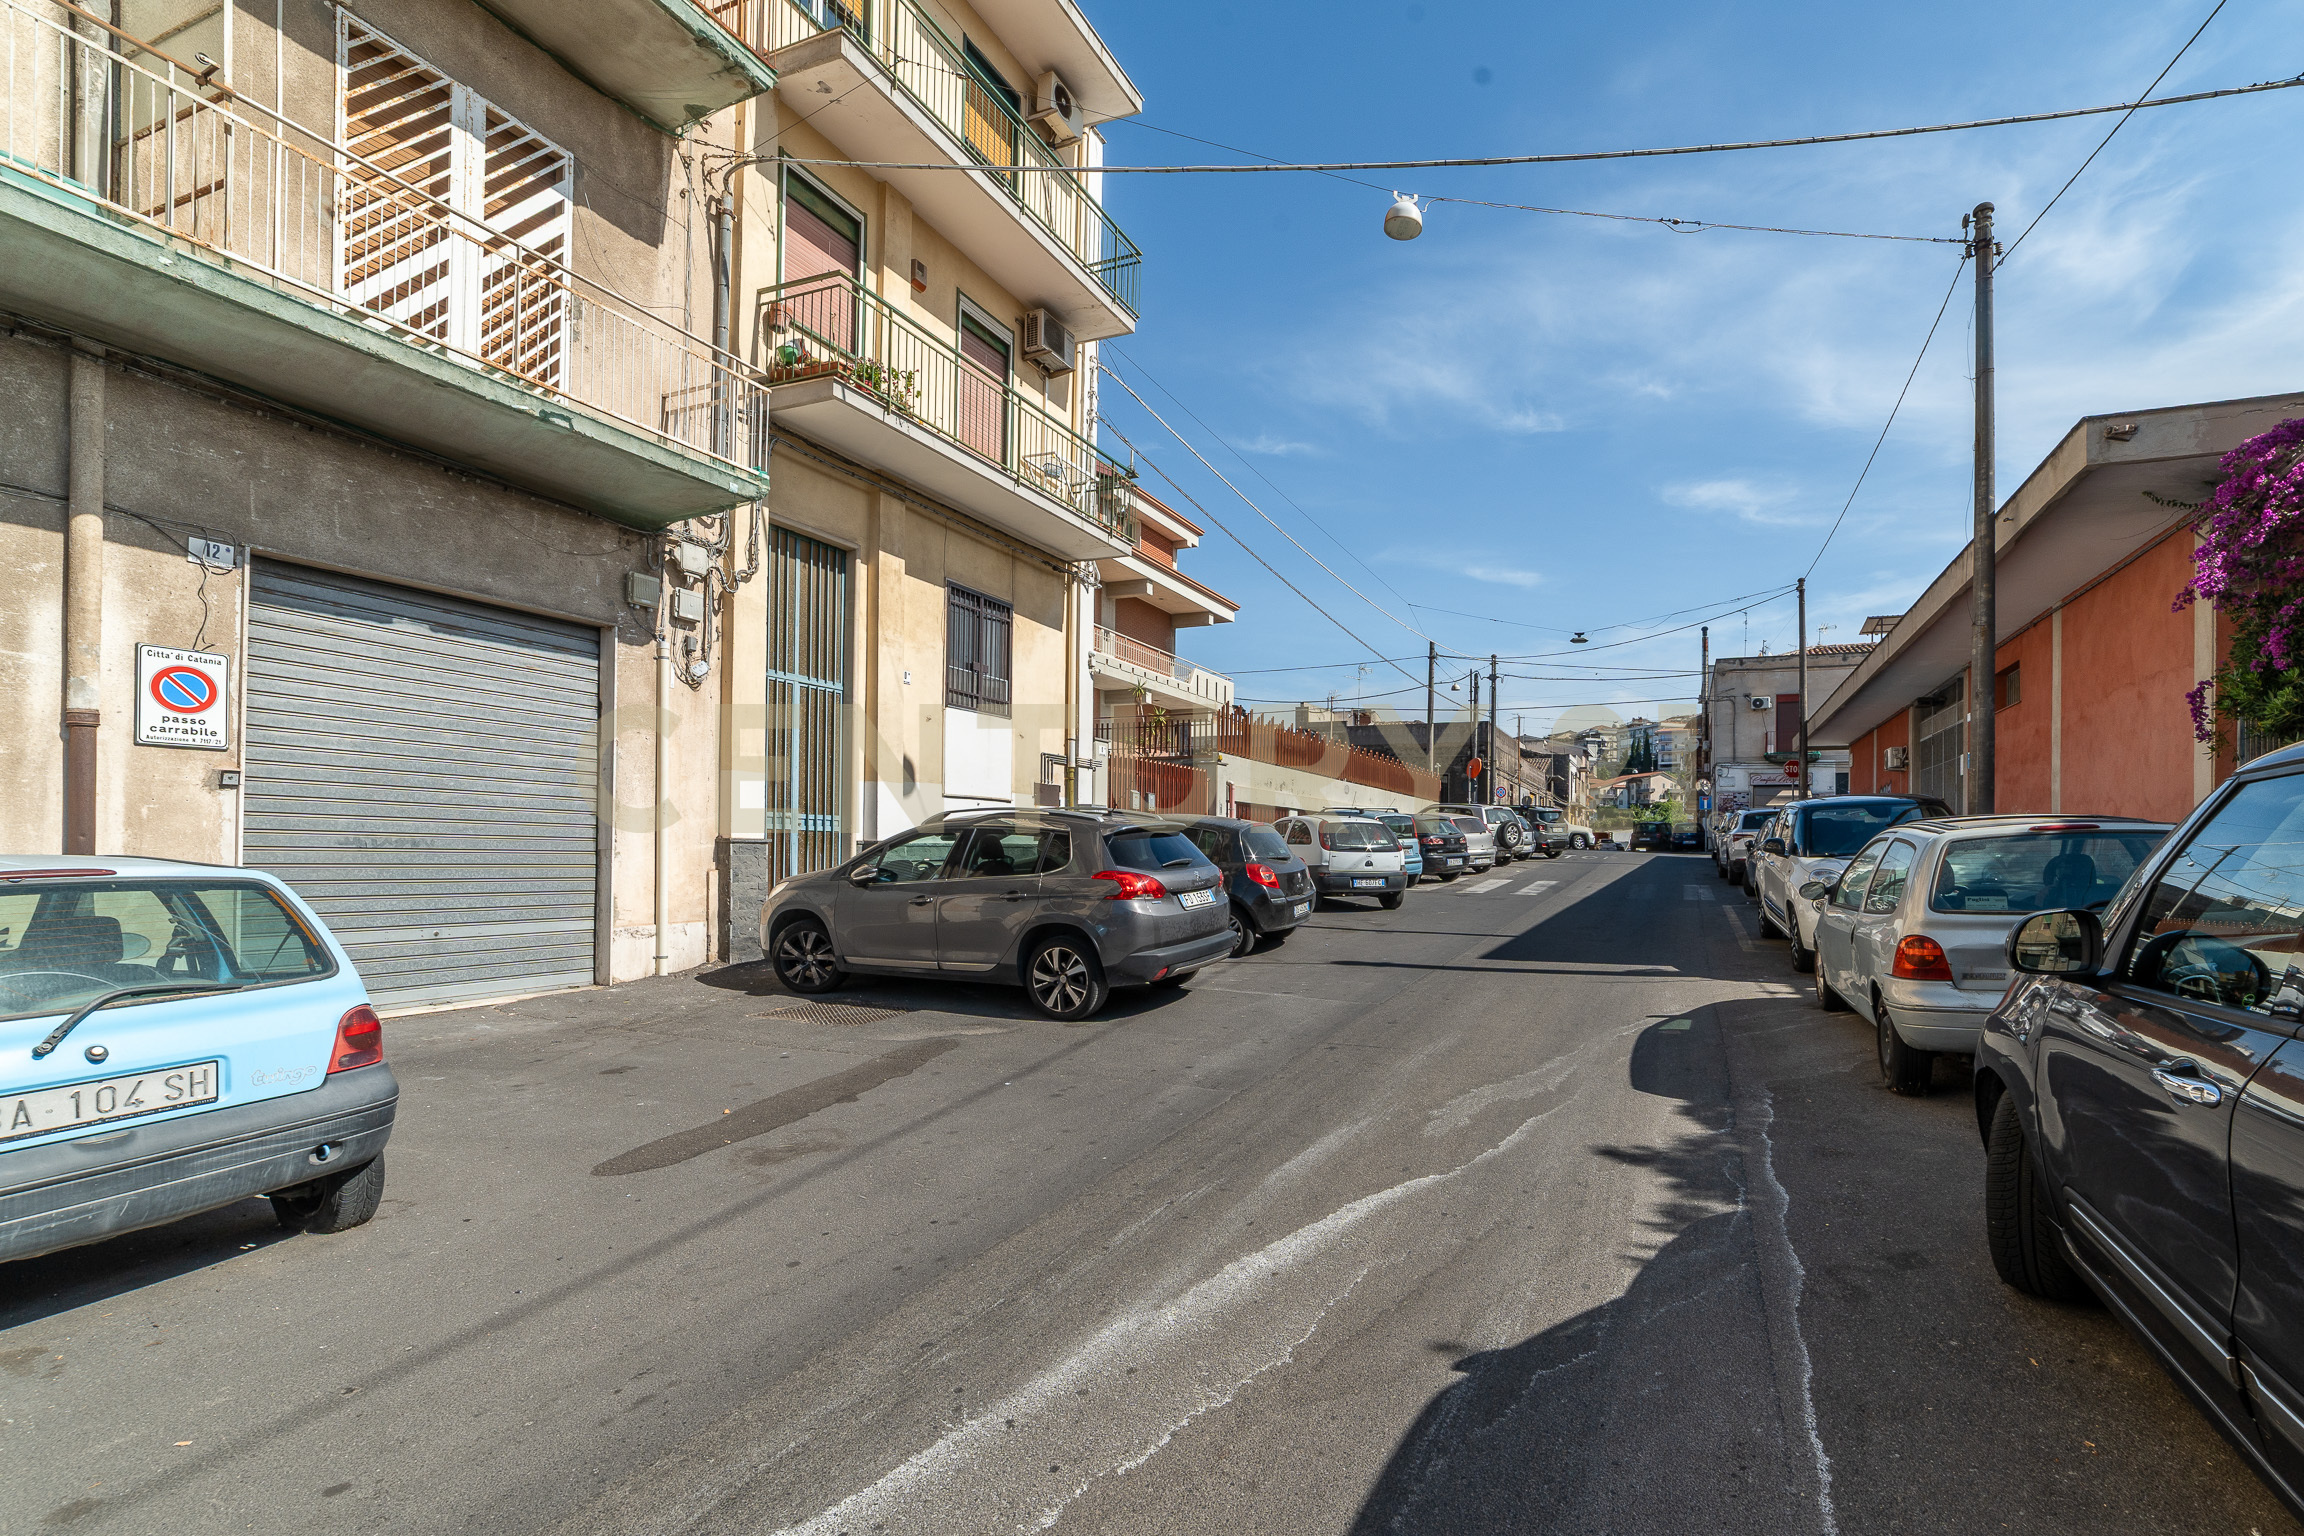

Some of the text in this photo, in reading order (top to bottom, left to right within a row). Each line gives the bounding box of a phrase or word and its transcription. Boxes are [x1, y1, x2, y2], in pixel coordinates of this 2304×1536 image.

[206, 543, 221, 560] 12
[187, 655, 222, 665] Catania
[162, 716, 206, 725] passo
[150, 725, 217, 737] carrabile
[1785, 763, 1799, 773] STO
[0, 1098, 33, 1130] A
[70, 1078, 145, 1119] 104
[164, 1066, 209, 1101] SH
